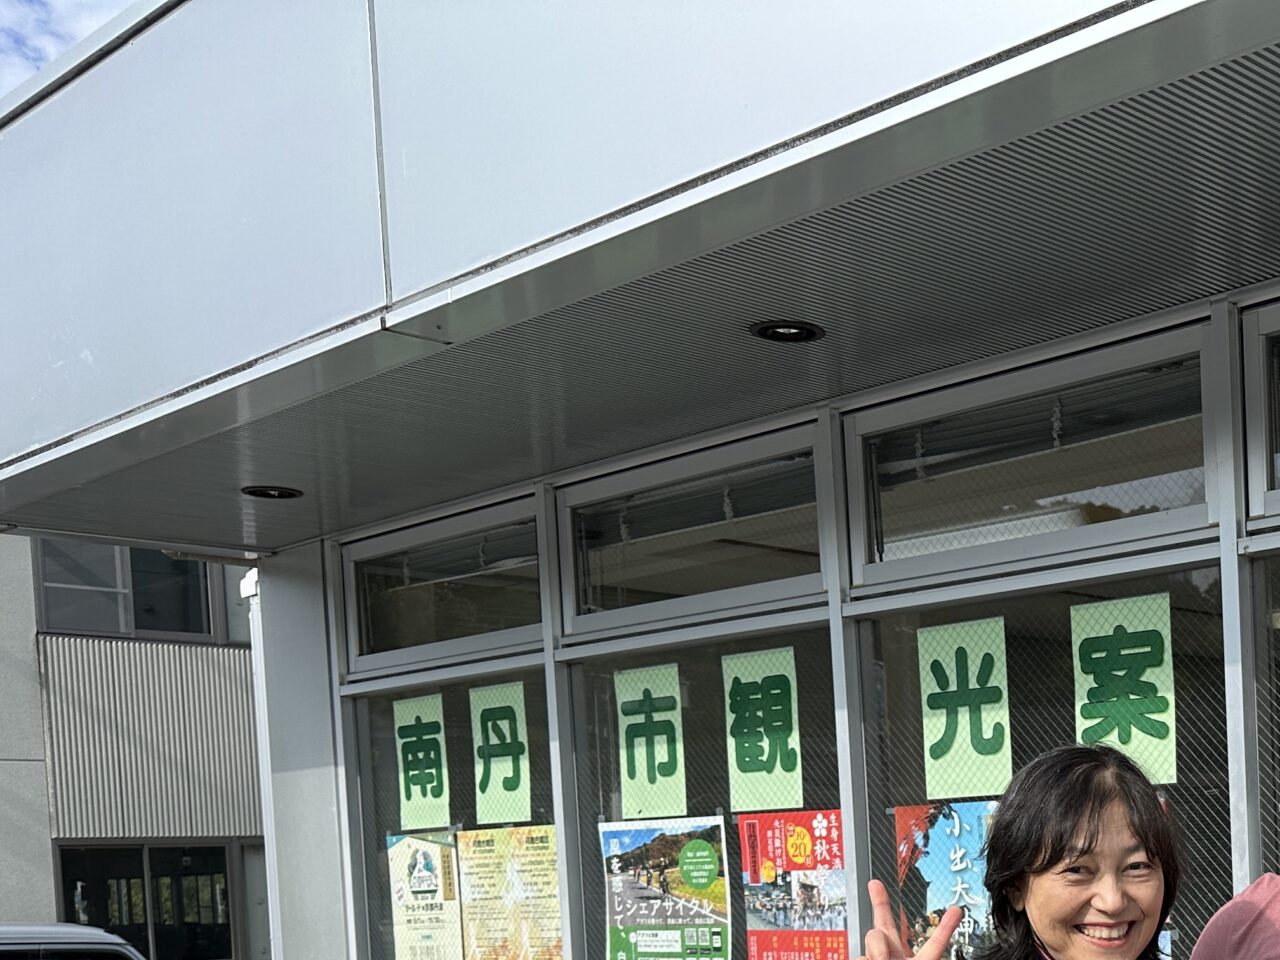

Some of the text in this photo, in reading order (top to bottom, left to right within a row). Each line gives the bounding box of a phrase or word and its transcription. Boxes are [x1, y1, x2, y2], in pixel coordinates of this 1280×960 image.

[626, 899, 715, 917] シェアサイクル
